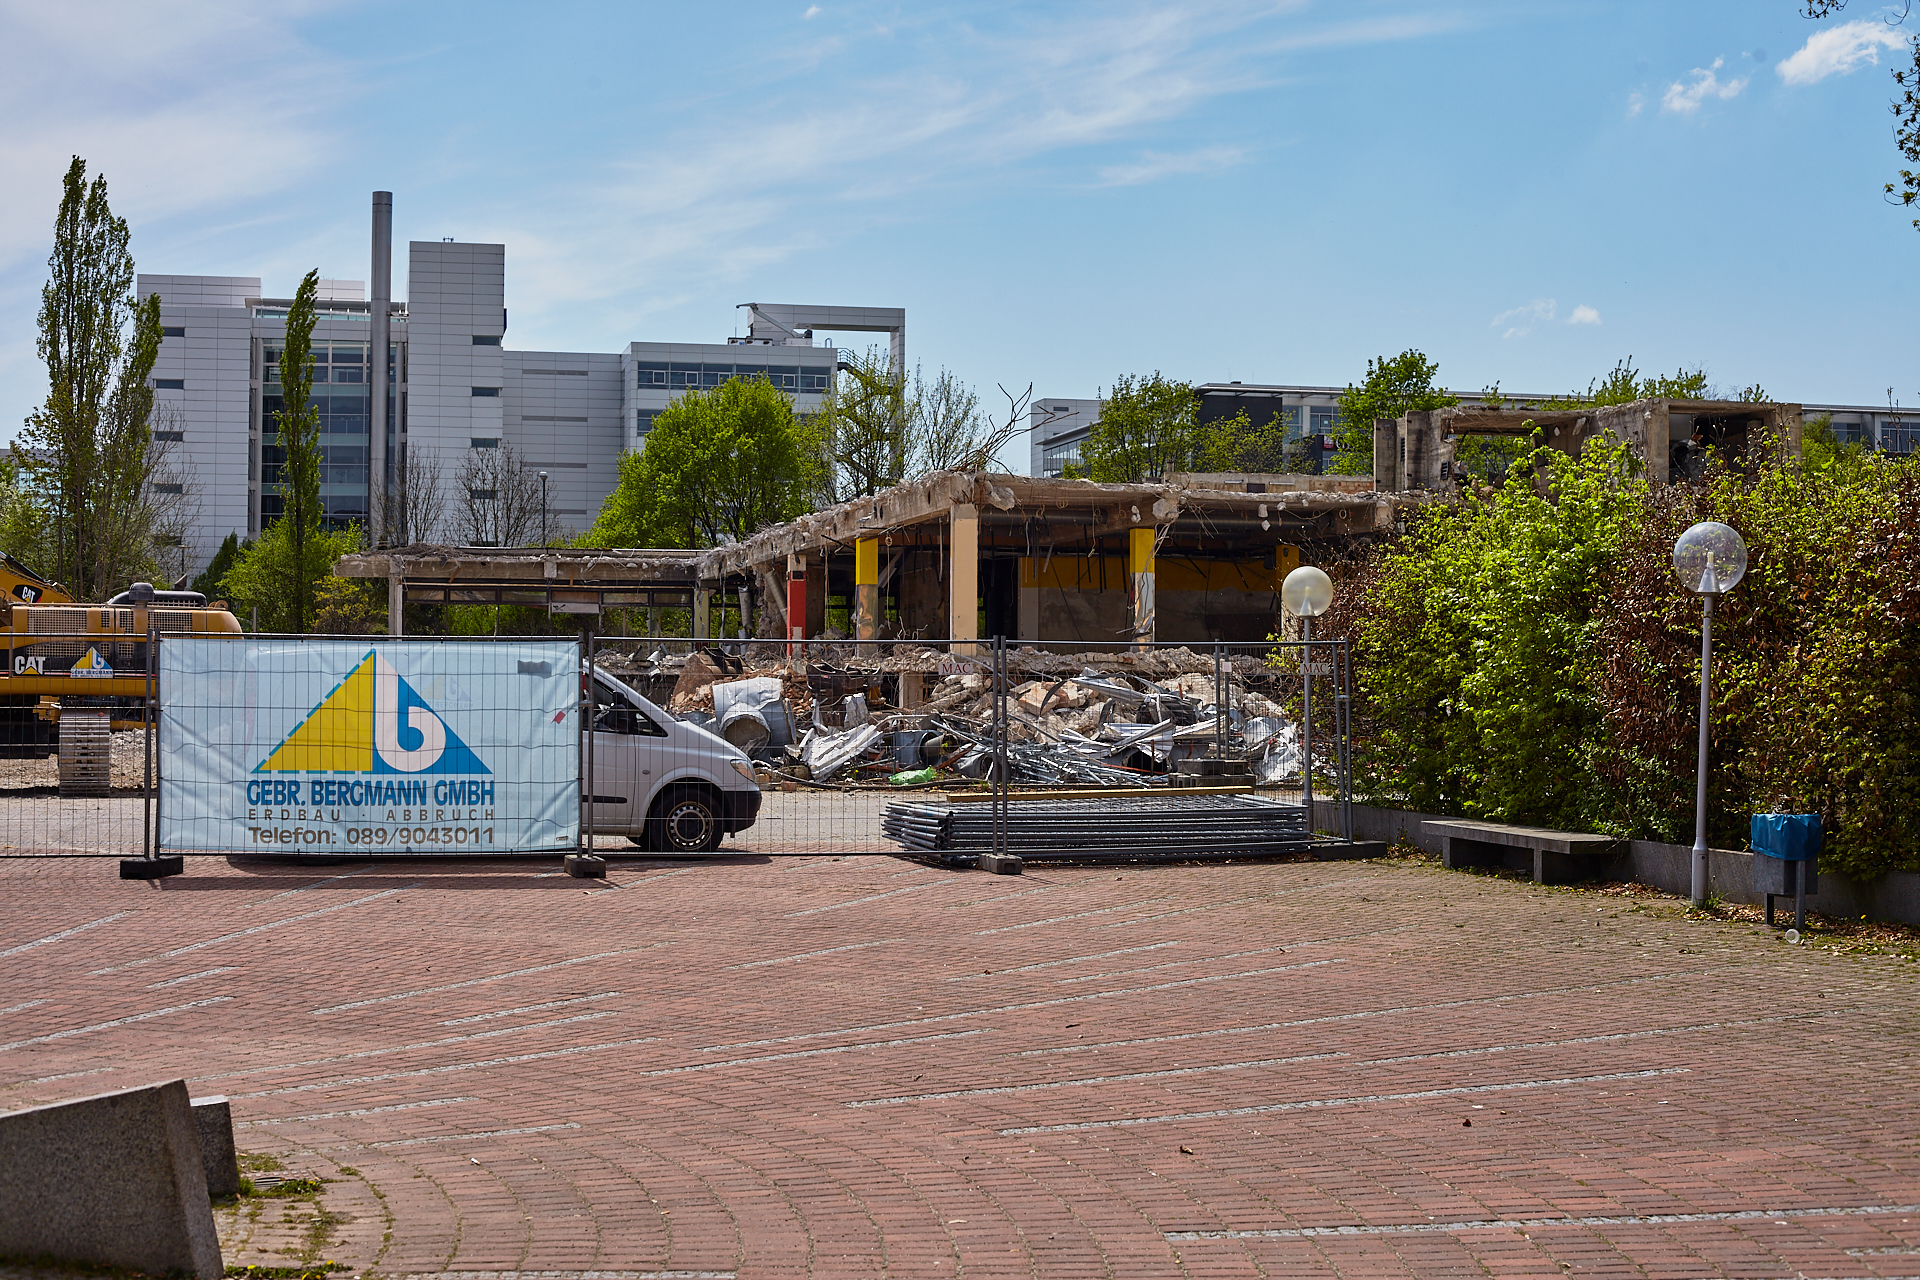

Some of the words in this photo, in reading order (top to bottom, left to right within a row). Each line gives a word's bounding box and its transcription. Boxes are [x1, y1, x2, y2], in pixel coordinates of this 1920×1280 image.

[22, 586, 36, 603] CAT
[14, 655, 46, 675] CAT
[942, 662, 971, 674] MAC
[1303, 663, 1327, 673] MAC
[246, 779, 306, 806] GEBR.
[311, 779, 427, 806] BERGMANN
[434, 779, 495, 806] GMBH
[248, 808, 341, 822] ERDBAU
[386, 808, 494, 822] ABBRUCH
[248, 826, 338, 845] Telefon:
[346, 826, 494, 846] 089/9043011
